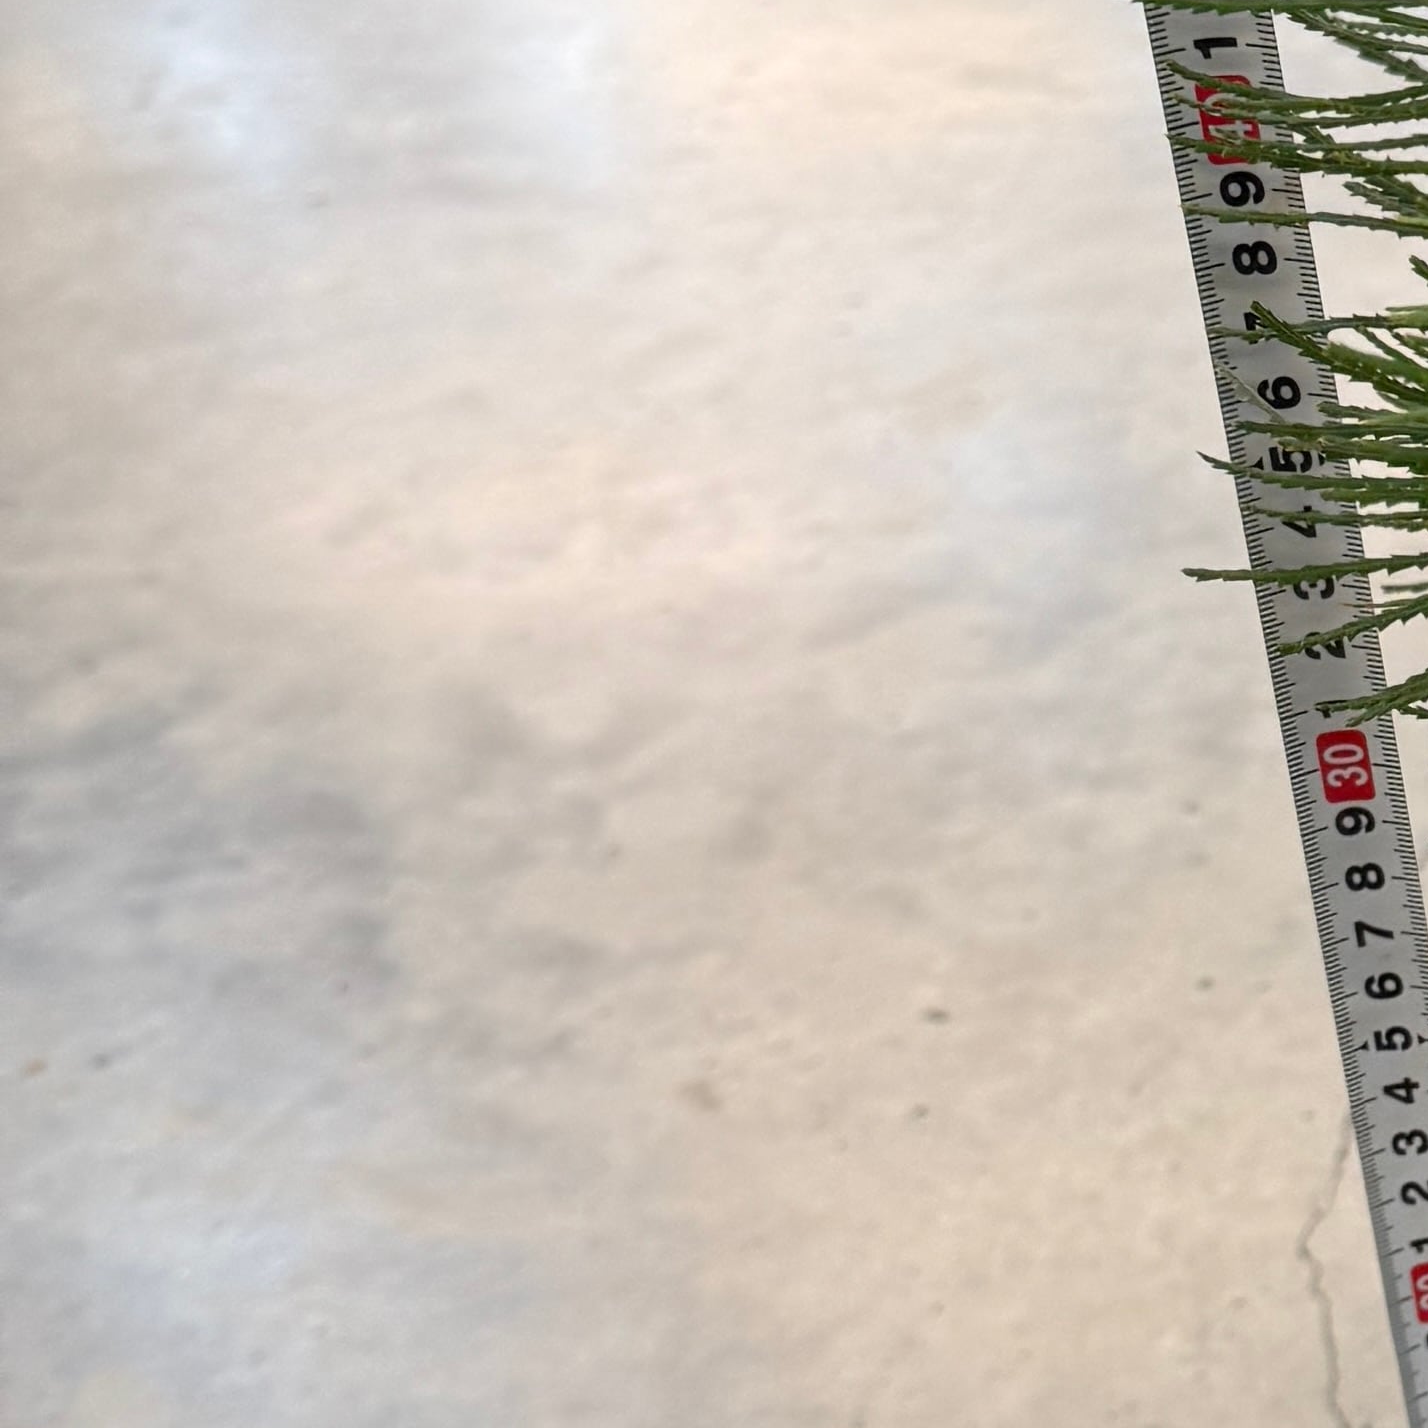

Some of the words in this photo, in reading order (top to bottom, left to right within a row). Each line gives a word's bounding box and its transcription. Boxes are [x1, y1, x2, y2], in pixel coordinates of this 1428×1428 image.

[1193, 37, 1237, 59] 1
[1220, 171, 1265, 207] 9
[1232, 241, 1277, 275] 8
[1257, 376, 1301, 409] 6
[1322, 742, 1370, 788] 30
[1335, 807, 1375, 836] 9
[1345, 862, 1385, 891] 8
[1354, 921, 1394, 947] 7
[1365, 972, 1403, 999] 6
[1374, 1026, 1412, 1052] 5
[1383, 1077, 1420, 1104] 4
